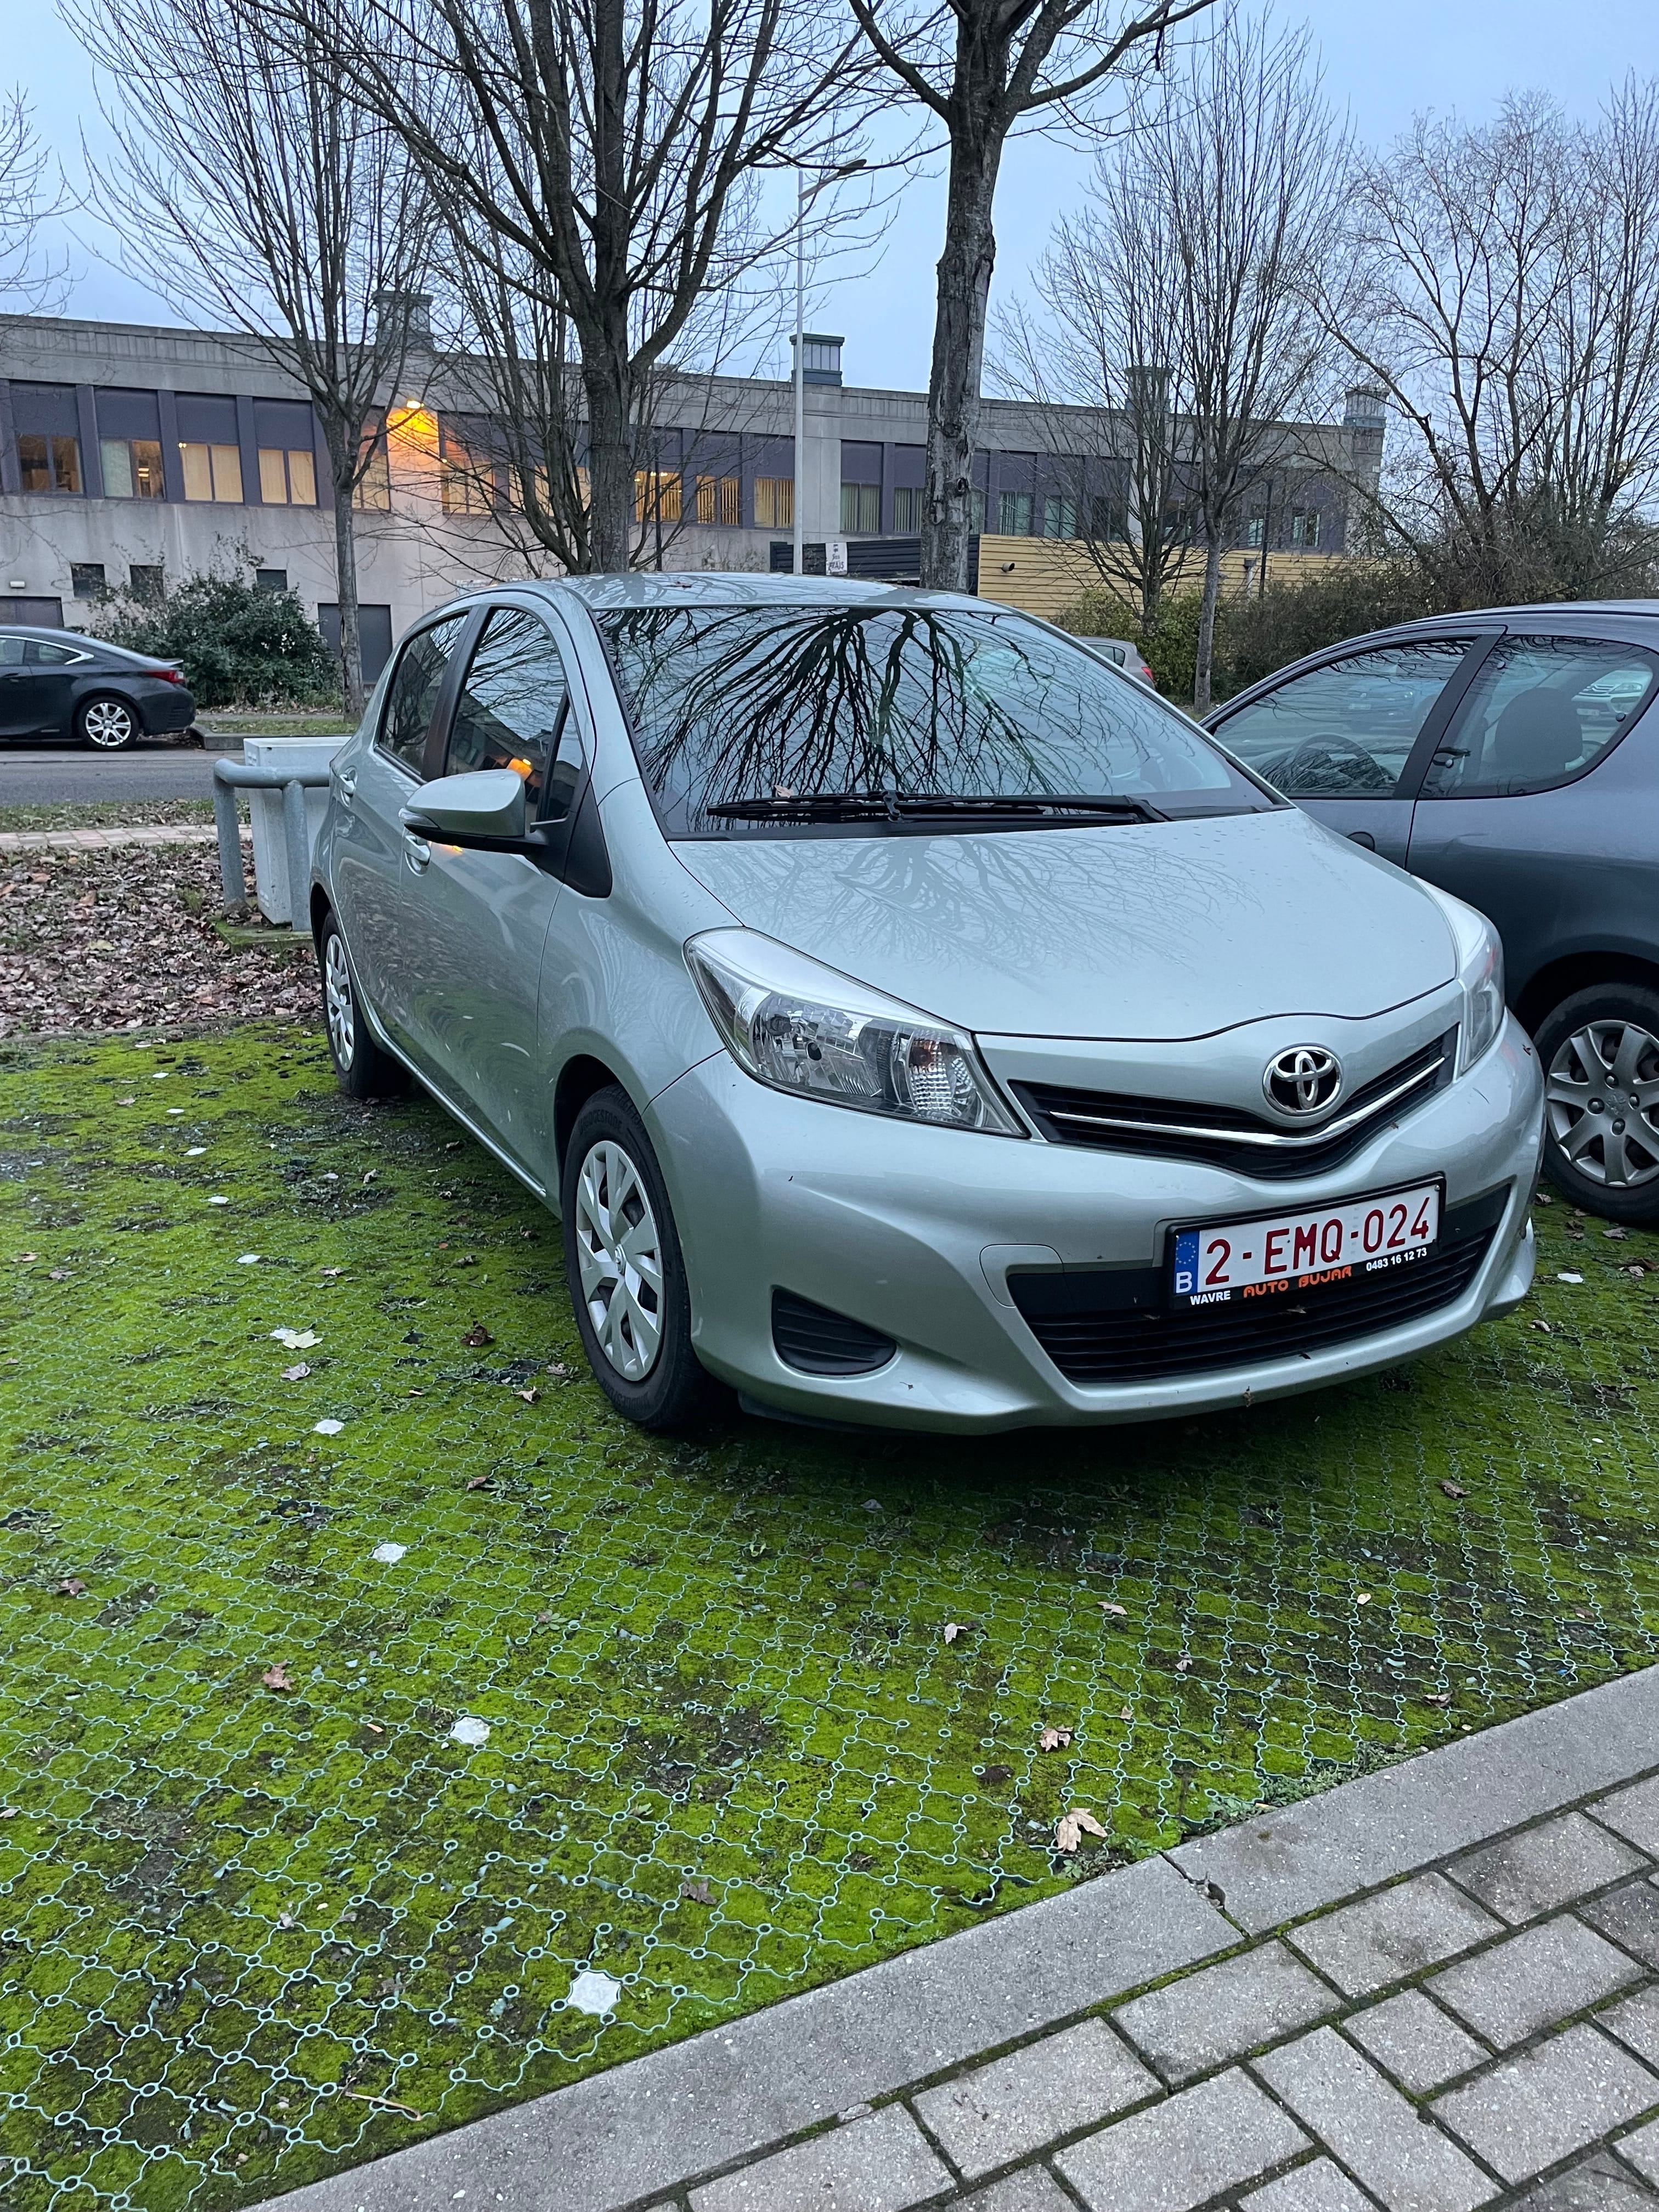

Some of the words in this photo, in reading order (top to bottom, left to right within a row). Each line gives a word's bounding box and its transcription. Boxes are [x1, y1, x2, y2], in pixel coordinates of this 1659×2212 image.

[1205, 1197, 1430, 1285] 2-EMQ-024
[1176, 1271, 1192, 1294] B
[1190, 1290, 1231, 1305] WAVRE
[1243, 1280, 1289, 1298] AUTO
[1298, 1266, 1351, 1288] BUJAR
[1366, 1257, 1389, 1271] 0483
[1391, 1254, 1402, 1265] 16
[1403, 1251, 1414, 1261] 12
[1416, 1247, 1427, 1258] 73
